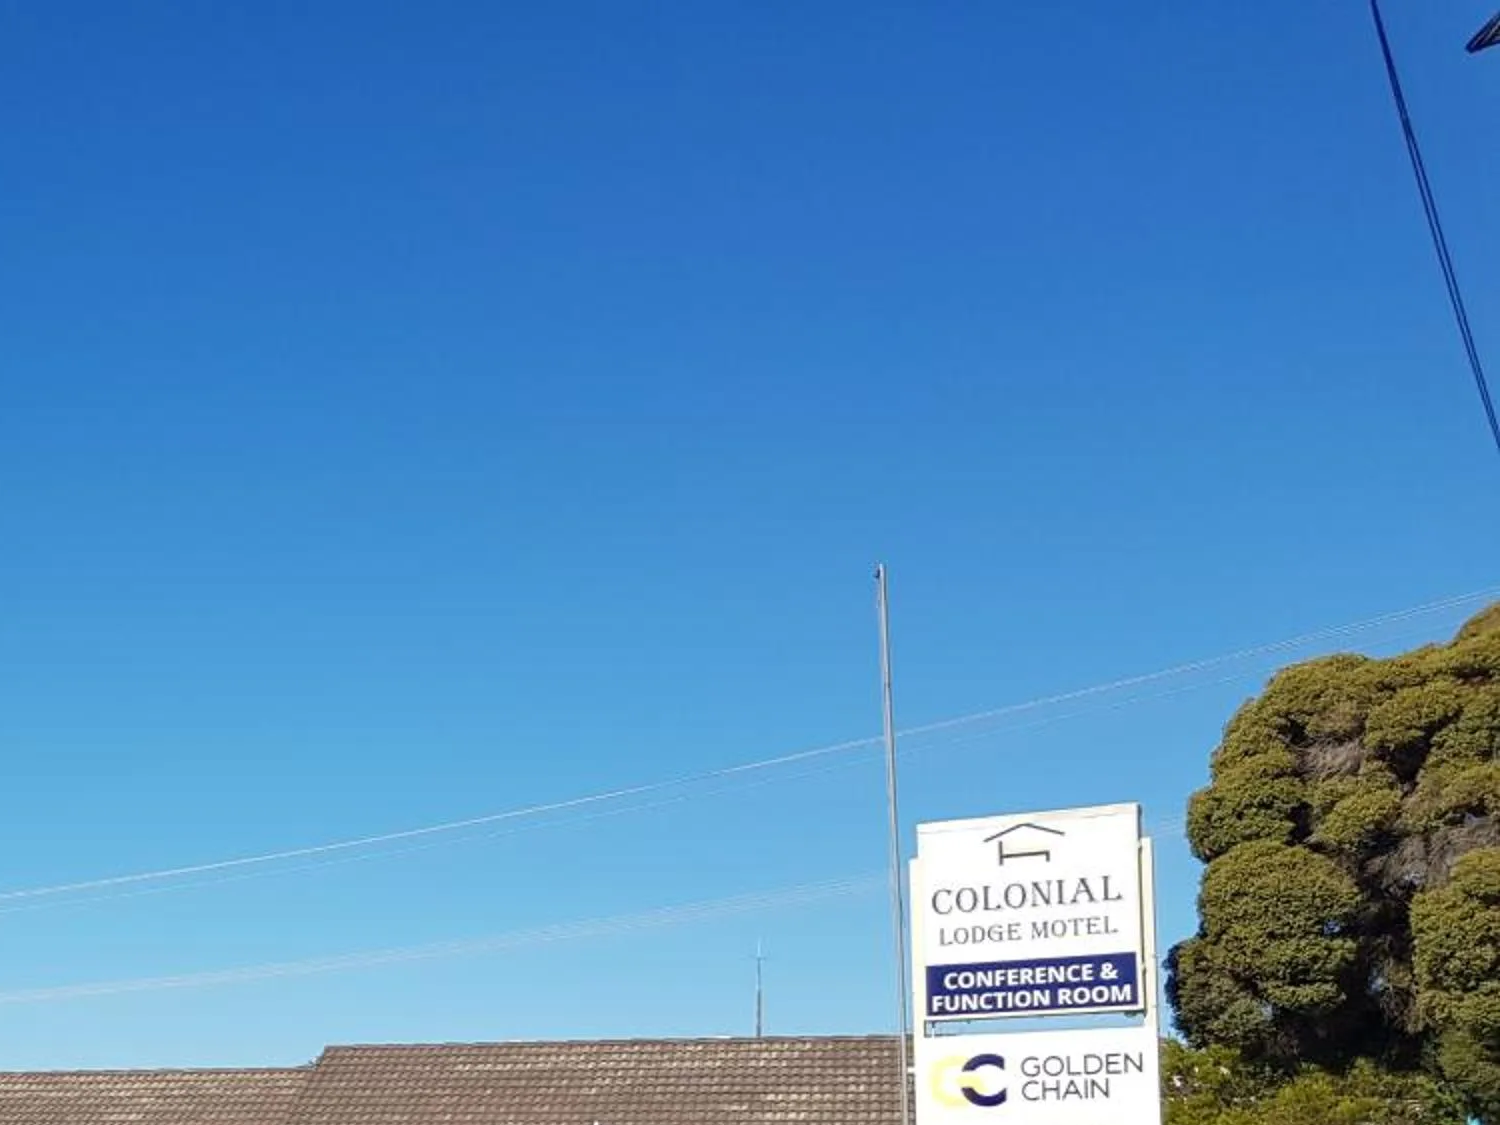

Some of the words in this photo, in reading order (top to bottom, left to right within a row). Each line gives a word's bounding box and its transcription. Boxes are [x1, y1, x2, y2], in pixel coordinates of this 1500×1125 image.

[931, 875, 1123, 915] COLONIAL
[939, 923, 1022, 946] LODGE
[1031, 916, 1119, 940] MOTEL
[943, 963, 1093, 990] CONFERENCE
[1101, 963, 1119, 980] &
[931, 990, 1050, 1013] FUNCTION
[1057, 983, 1132, 1005] ROOM
[1020, 1052, 1143, 1077] GOLDEN
[1021, 1077, 1110, 1101] CHAIN
